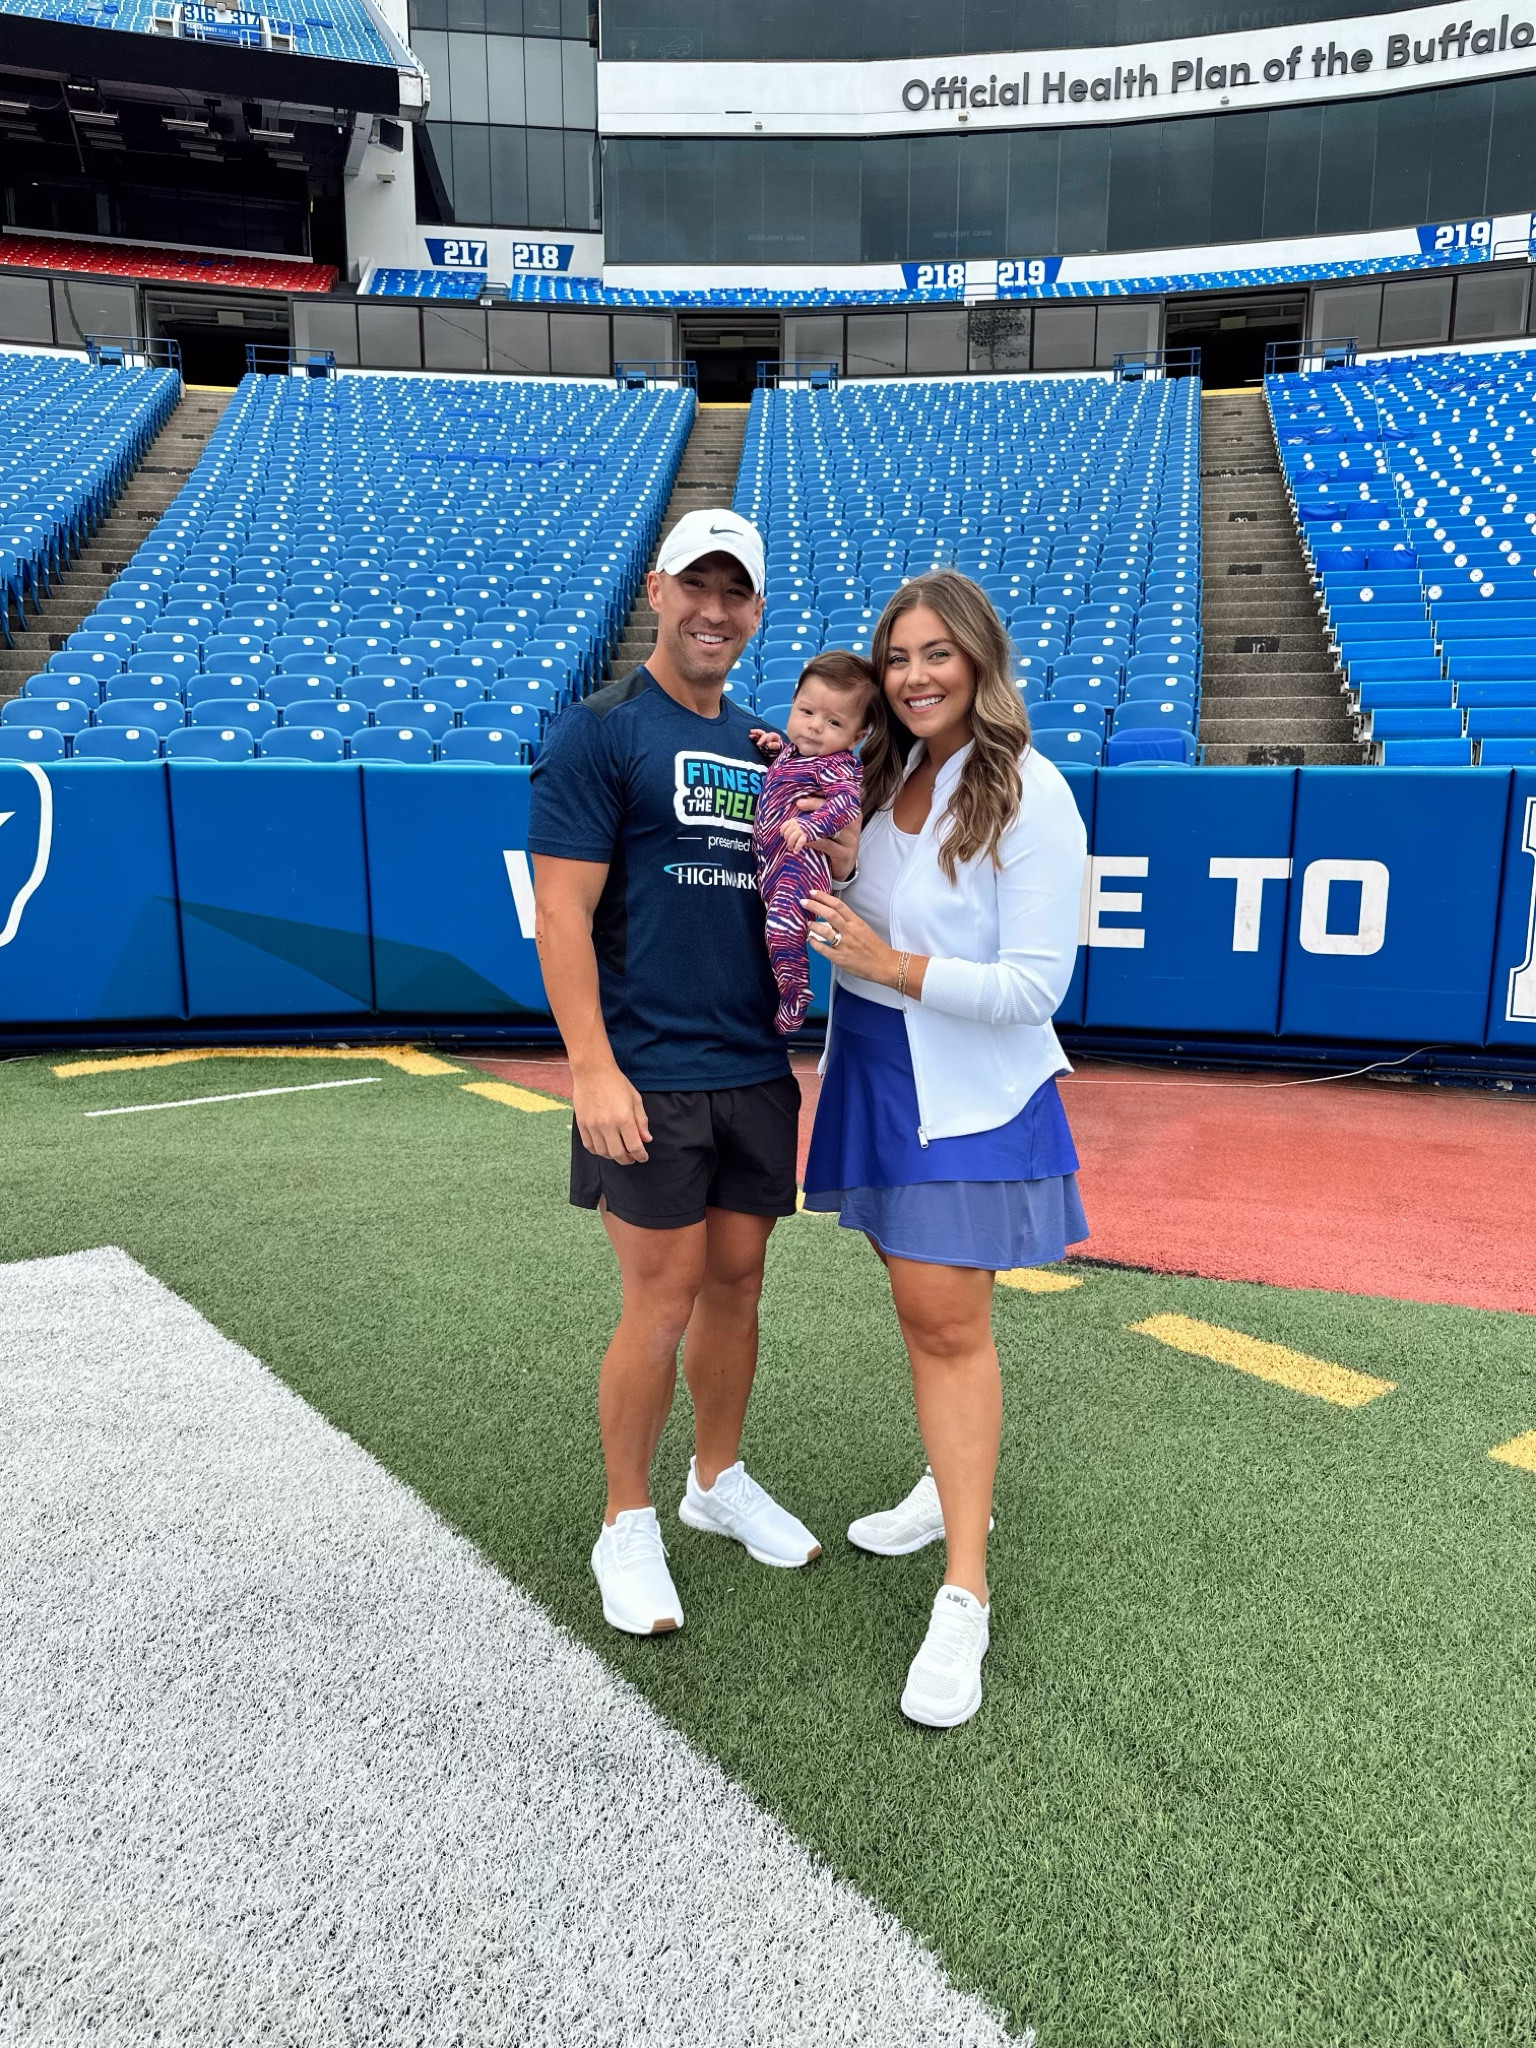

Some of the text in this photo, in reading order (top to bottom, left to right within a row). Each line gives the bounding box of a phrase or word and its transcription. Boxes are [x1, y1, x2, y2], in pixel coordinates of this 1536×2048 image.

[184, 4, 216, 23] 316
[230, 10, 260, 25] 317
[902, 14, 1535, 111] Official Health Plan of the Buffalo
[1435, 221, 1491, 250] 219
[443, 240, 486, 266] 217
[513, 244, 559, 270] 218
[917, 264, 965, 289] 218
[998, 260, 1046, 287] 219
[694, 786, 713, 799] ON
[715, 788, 756, 821] FIEL
[687, 799, 713, 812] THE
[708, 835, 751, 852] presented
[678, 866, 758, 890] HIGHMARK
[1208, 857, 1390, 956] TO
